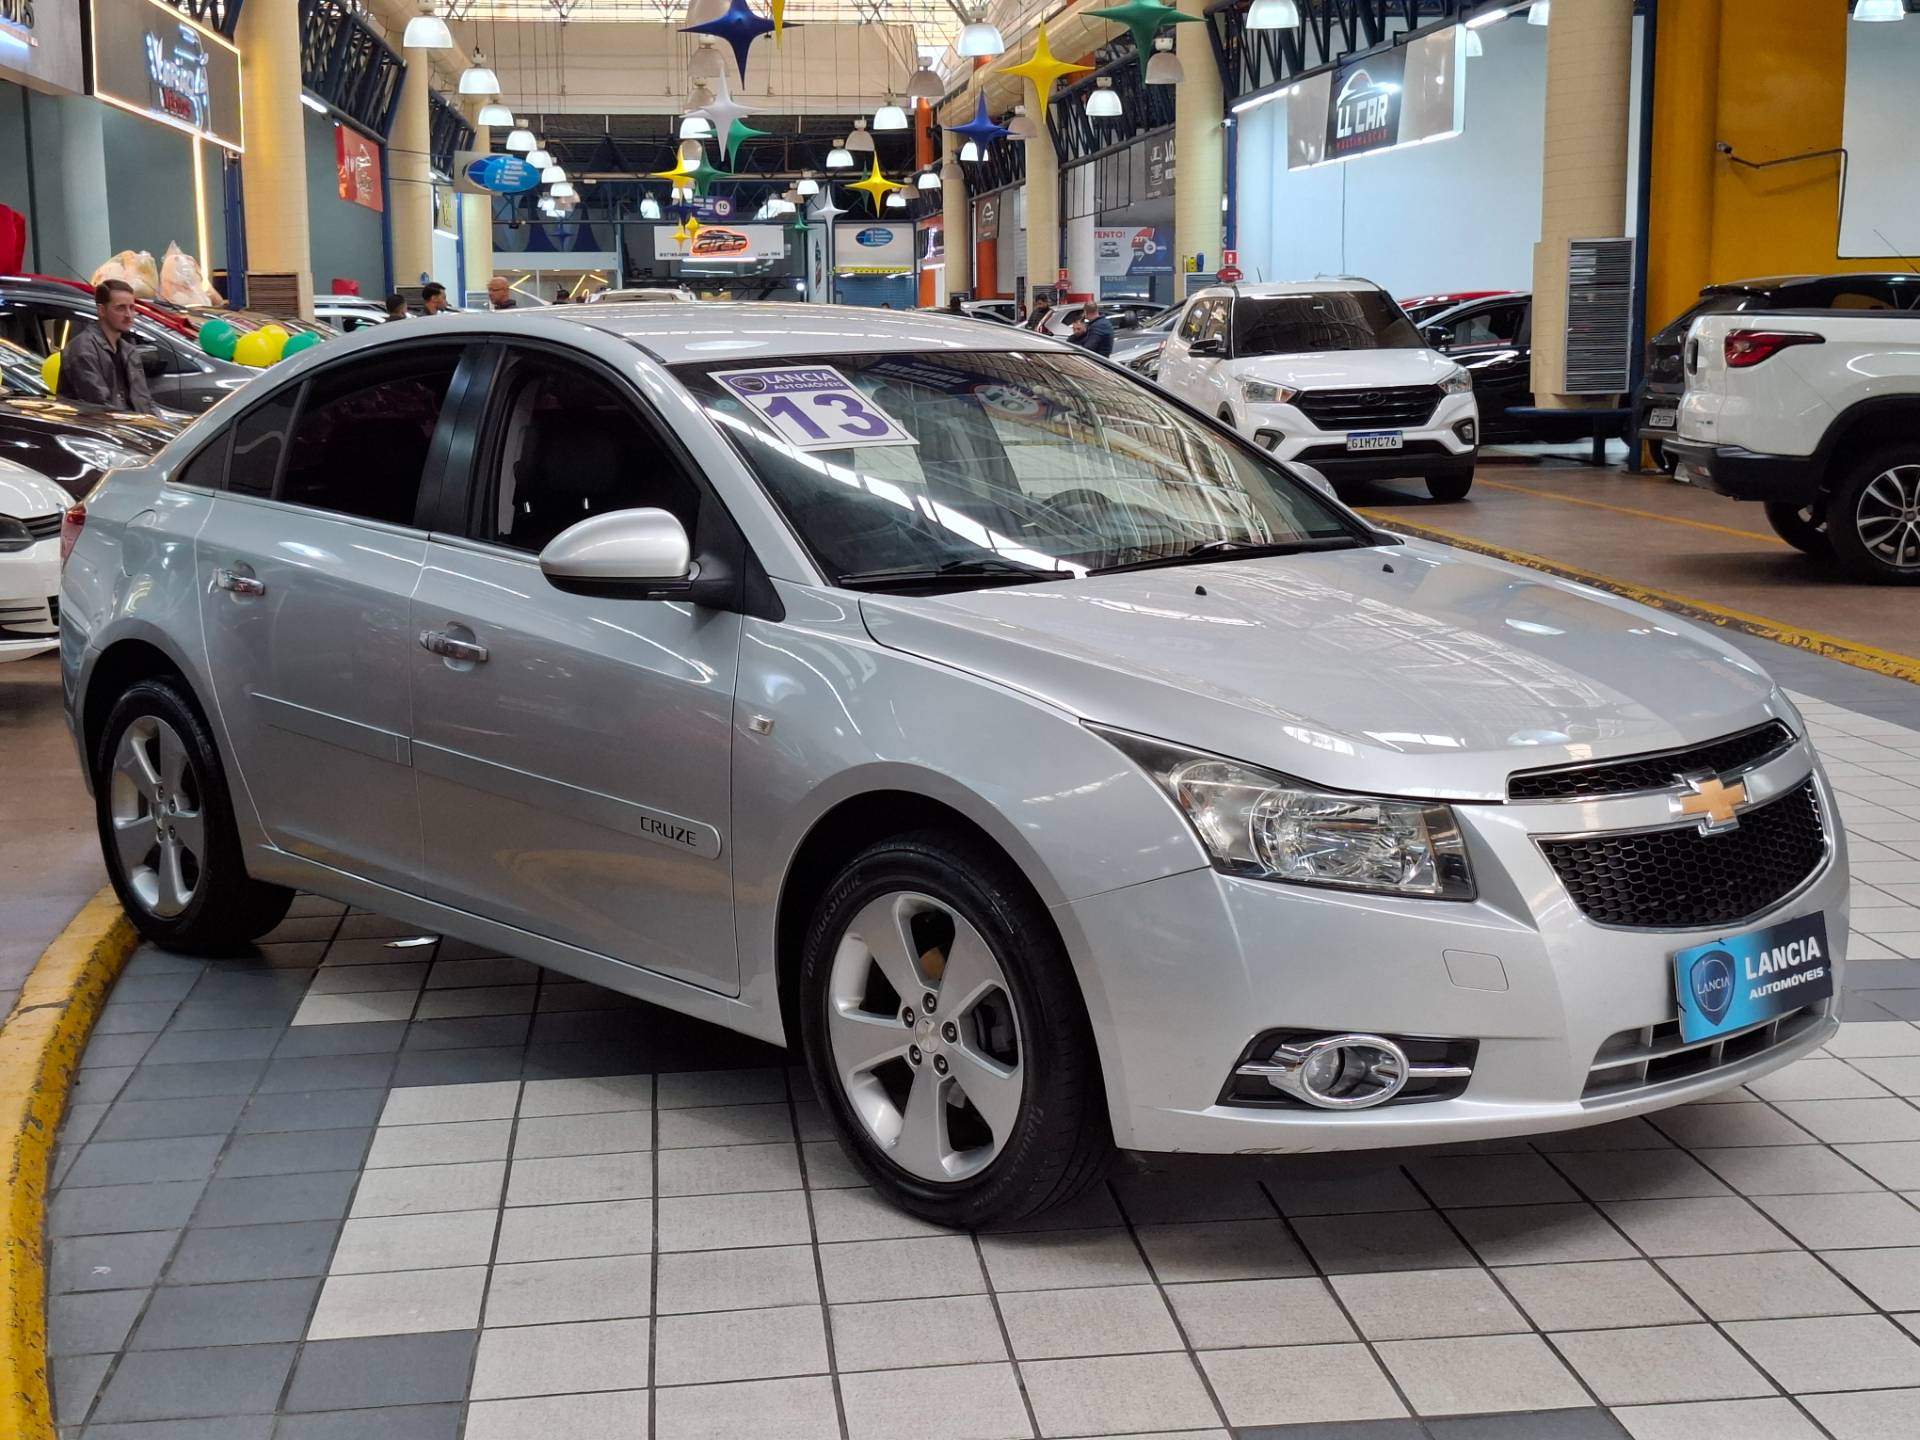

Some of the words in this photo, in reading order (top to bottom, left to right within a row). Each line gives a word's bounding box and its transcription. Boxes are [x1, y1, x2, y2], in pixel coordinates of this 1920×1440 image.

[1336, 105, 1352, 138] LL
[1355, 93, 1388, 133] CAR
[761, 372, 838, 385] LANCIA
[763, 394, 889, 439] 13
[640, 816, 697, 847] CRUZE
[1745, 936, 1822, 980] LANCIA
[1696, 976, 1731, 995] LANCIA
[1749, 966, 1824, 999] AUTOMÓVEIS
